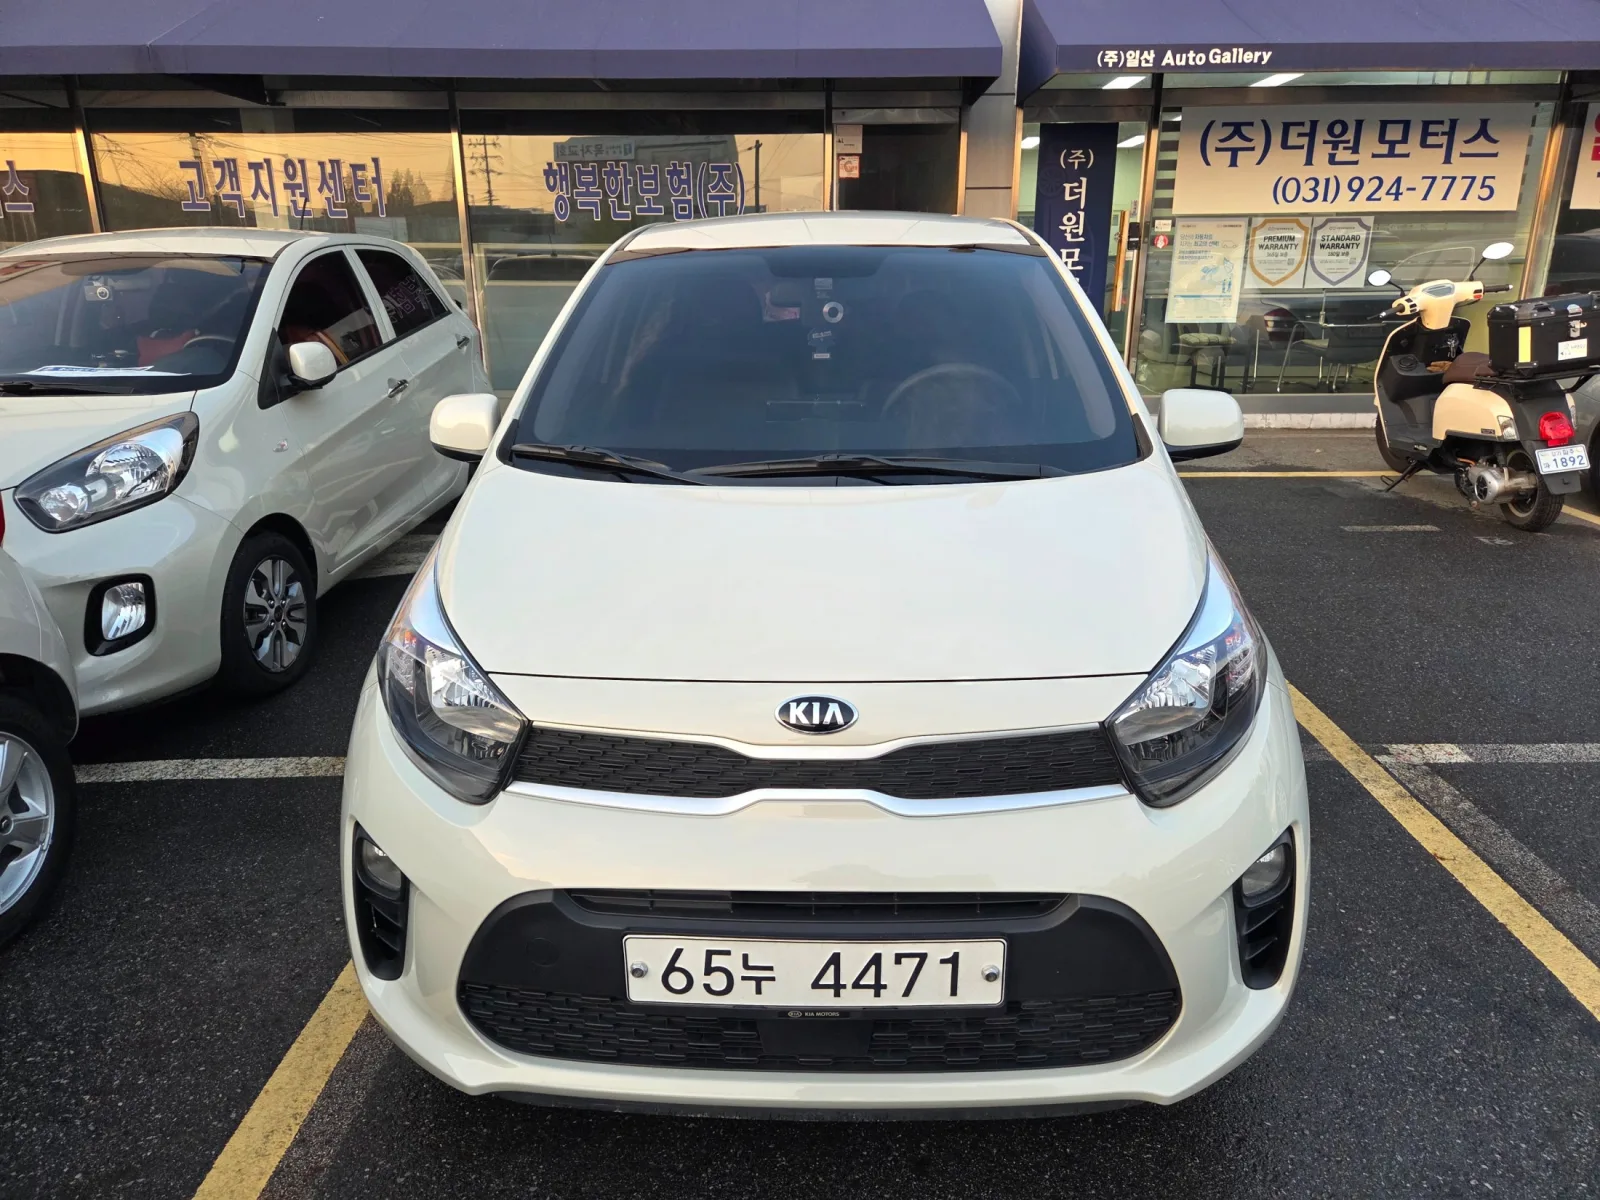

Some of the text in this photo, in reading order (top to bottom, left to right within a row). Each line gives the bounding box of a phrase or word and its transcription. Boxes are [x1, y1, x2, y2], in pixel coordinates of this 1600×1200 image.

[1097, 48, 1272, 68] (주)일산 Auto Gallery
[1200, 118, 1500, 167] (주)더원모터스
[178, 157, 386, 218] 고객지원센터
[543, 161, 745, 221] 행복한보험(주)
[1263, 235, 1296, 243] PREMIUM
[1319, 242, 1361, 250] WARRANTY
[1320, 234, 1361, 242] STANDARD
[1258, 243, 1299, 251] WARRANTY
[1553, 455, 1585, 468] 1892
[661, 948, 960, 998] 65누 4471
